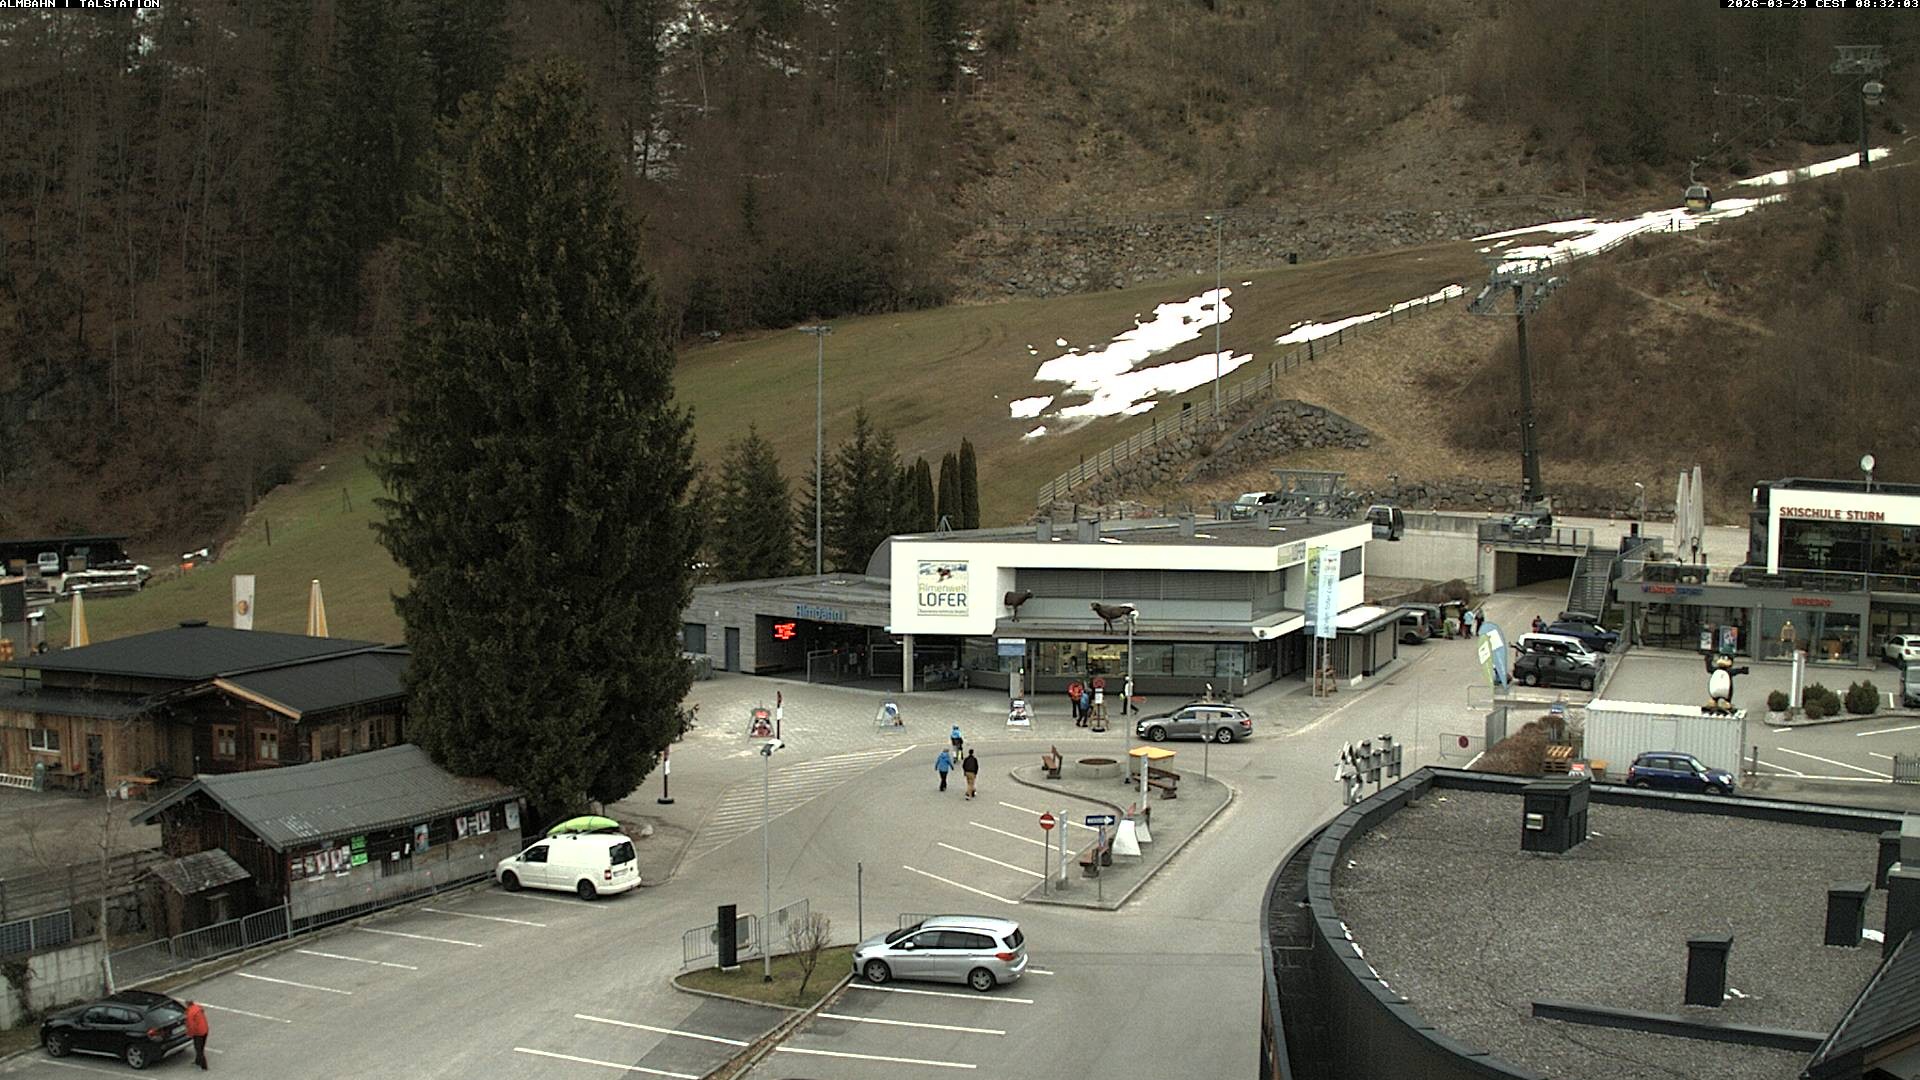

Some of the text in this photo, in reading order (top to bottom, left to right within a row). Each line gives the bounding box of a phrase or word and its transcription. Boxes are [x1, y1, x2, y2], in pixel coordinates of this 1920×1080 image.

[1779, 506, 1885, 521] SKISCHULE STURM
[919, 592, 967, 607] LOFER
